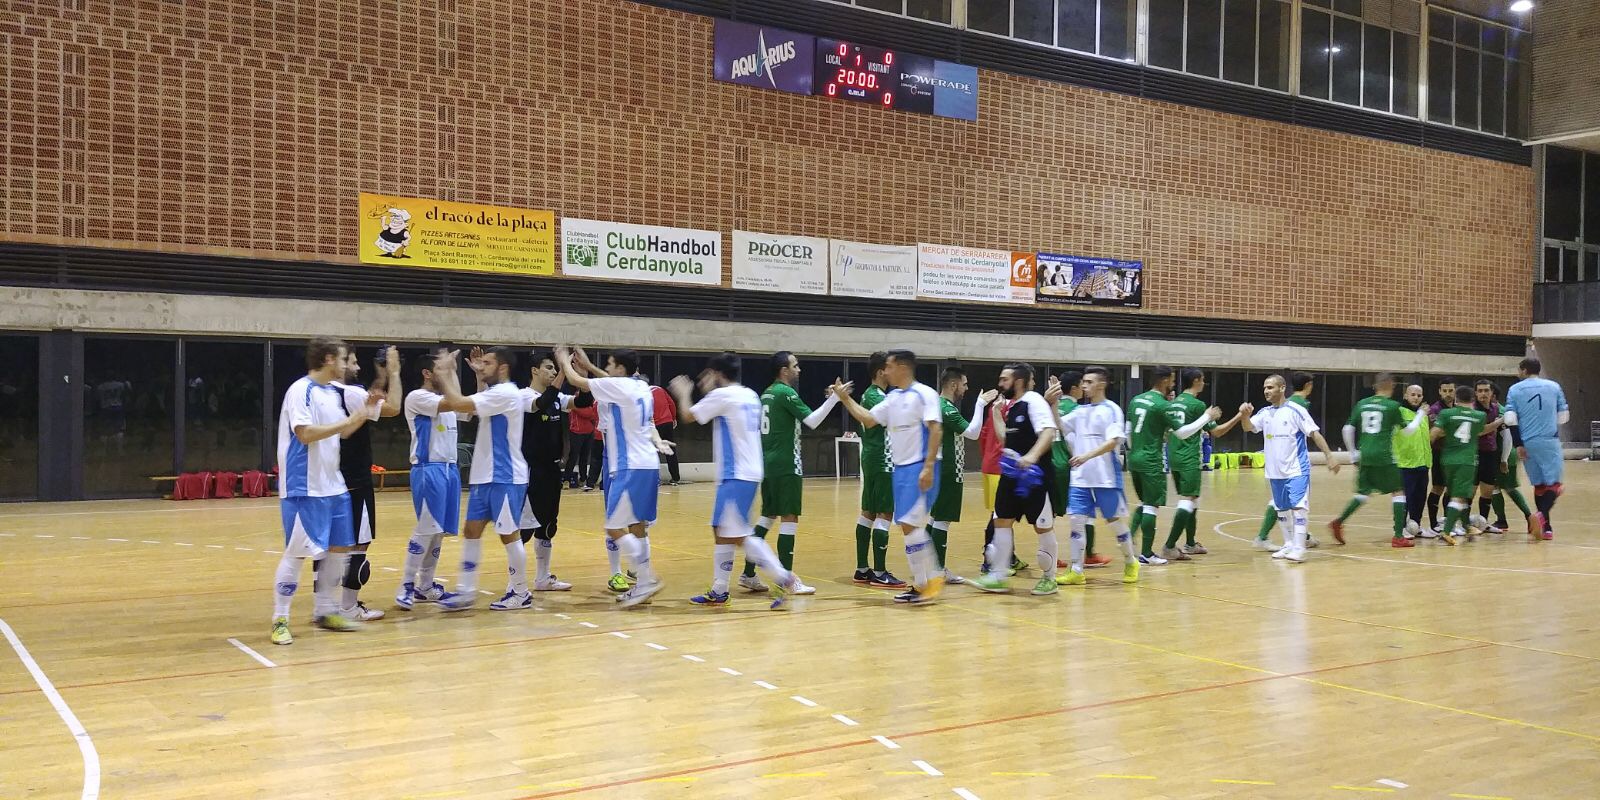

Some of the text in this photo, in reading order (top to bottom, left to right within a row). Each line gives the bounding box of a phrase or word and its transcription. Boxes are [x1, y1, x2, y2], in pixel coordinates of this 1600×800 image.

[840, 44, 847, 55] 0
[731, 28, 796, 88] AQUARIUS
[825, 54, 842, 66] LOCAL
[856, 55, 861, 66] 1
[885, 52, 892, 64] 0
[867, 62, 890, 74] VISITANT
[900, 72, 972, 91] POWERADE
[828, 83, 836, 96] 0
[884, 92, 891, 105] 0
[425, 206, 547, 232] el racó de la plaça
[420, 230, 481, 240] PIZZES ARTESANES
[430, 239, 446, 247] FORN
[606, 231, 717, 257] ClubHandbol
[423, 249, 440, 257] Plaça
[921, 246, 949, 255] MERCAT
[950, 248, 961, 256] DE
[961, 250, 1008, 260] SERRAPARERA
[606, 251, 704, 276] Cerdanyola
[760, 404, 770, 435] 6
[1134, 407, 1147, 433] 7
[1453, 421, 1472, 444] 4
